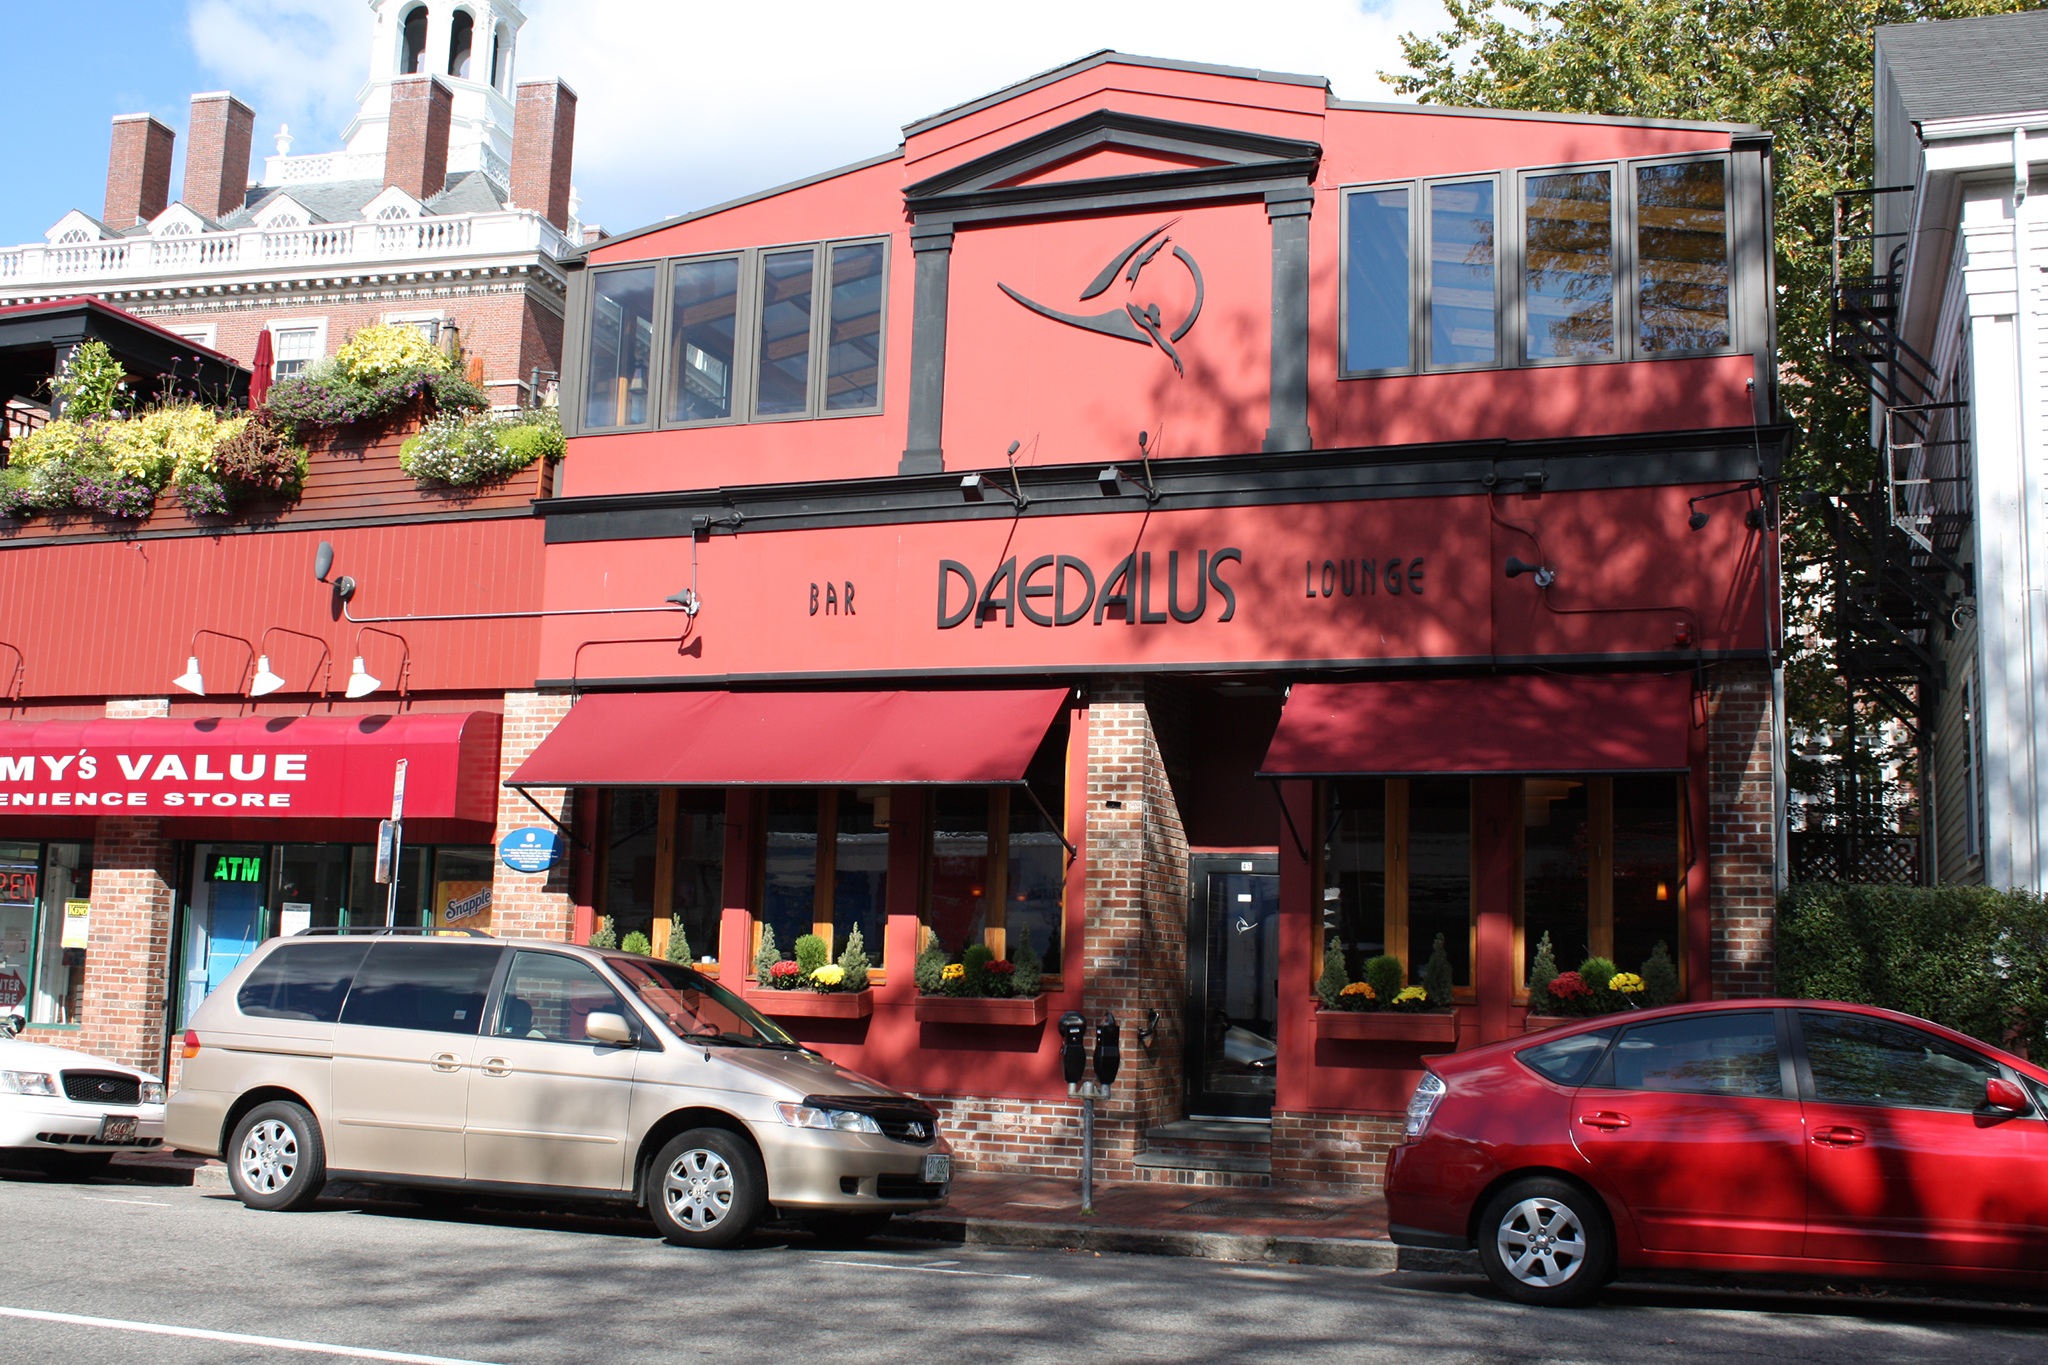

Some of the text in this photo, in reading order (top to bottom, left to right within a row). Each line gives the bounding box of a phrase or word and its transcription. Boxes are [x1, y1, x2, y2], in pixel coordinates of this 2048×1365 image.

[810, 548, 1424, 630] BAR DAEDALUS LOUNGE
[116, 754, 308, 781] VALUE
[163, 793, 291, 807] STORE
[214, 856, 261, 882] ATM
[445, 887, 492, 920] Snapple
